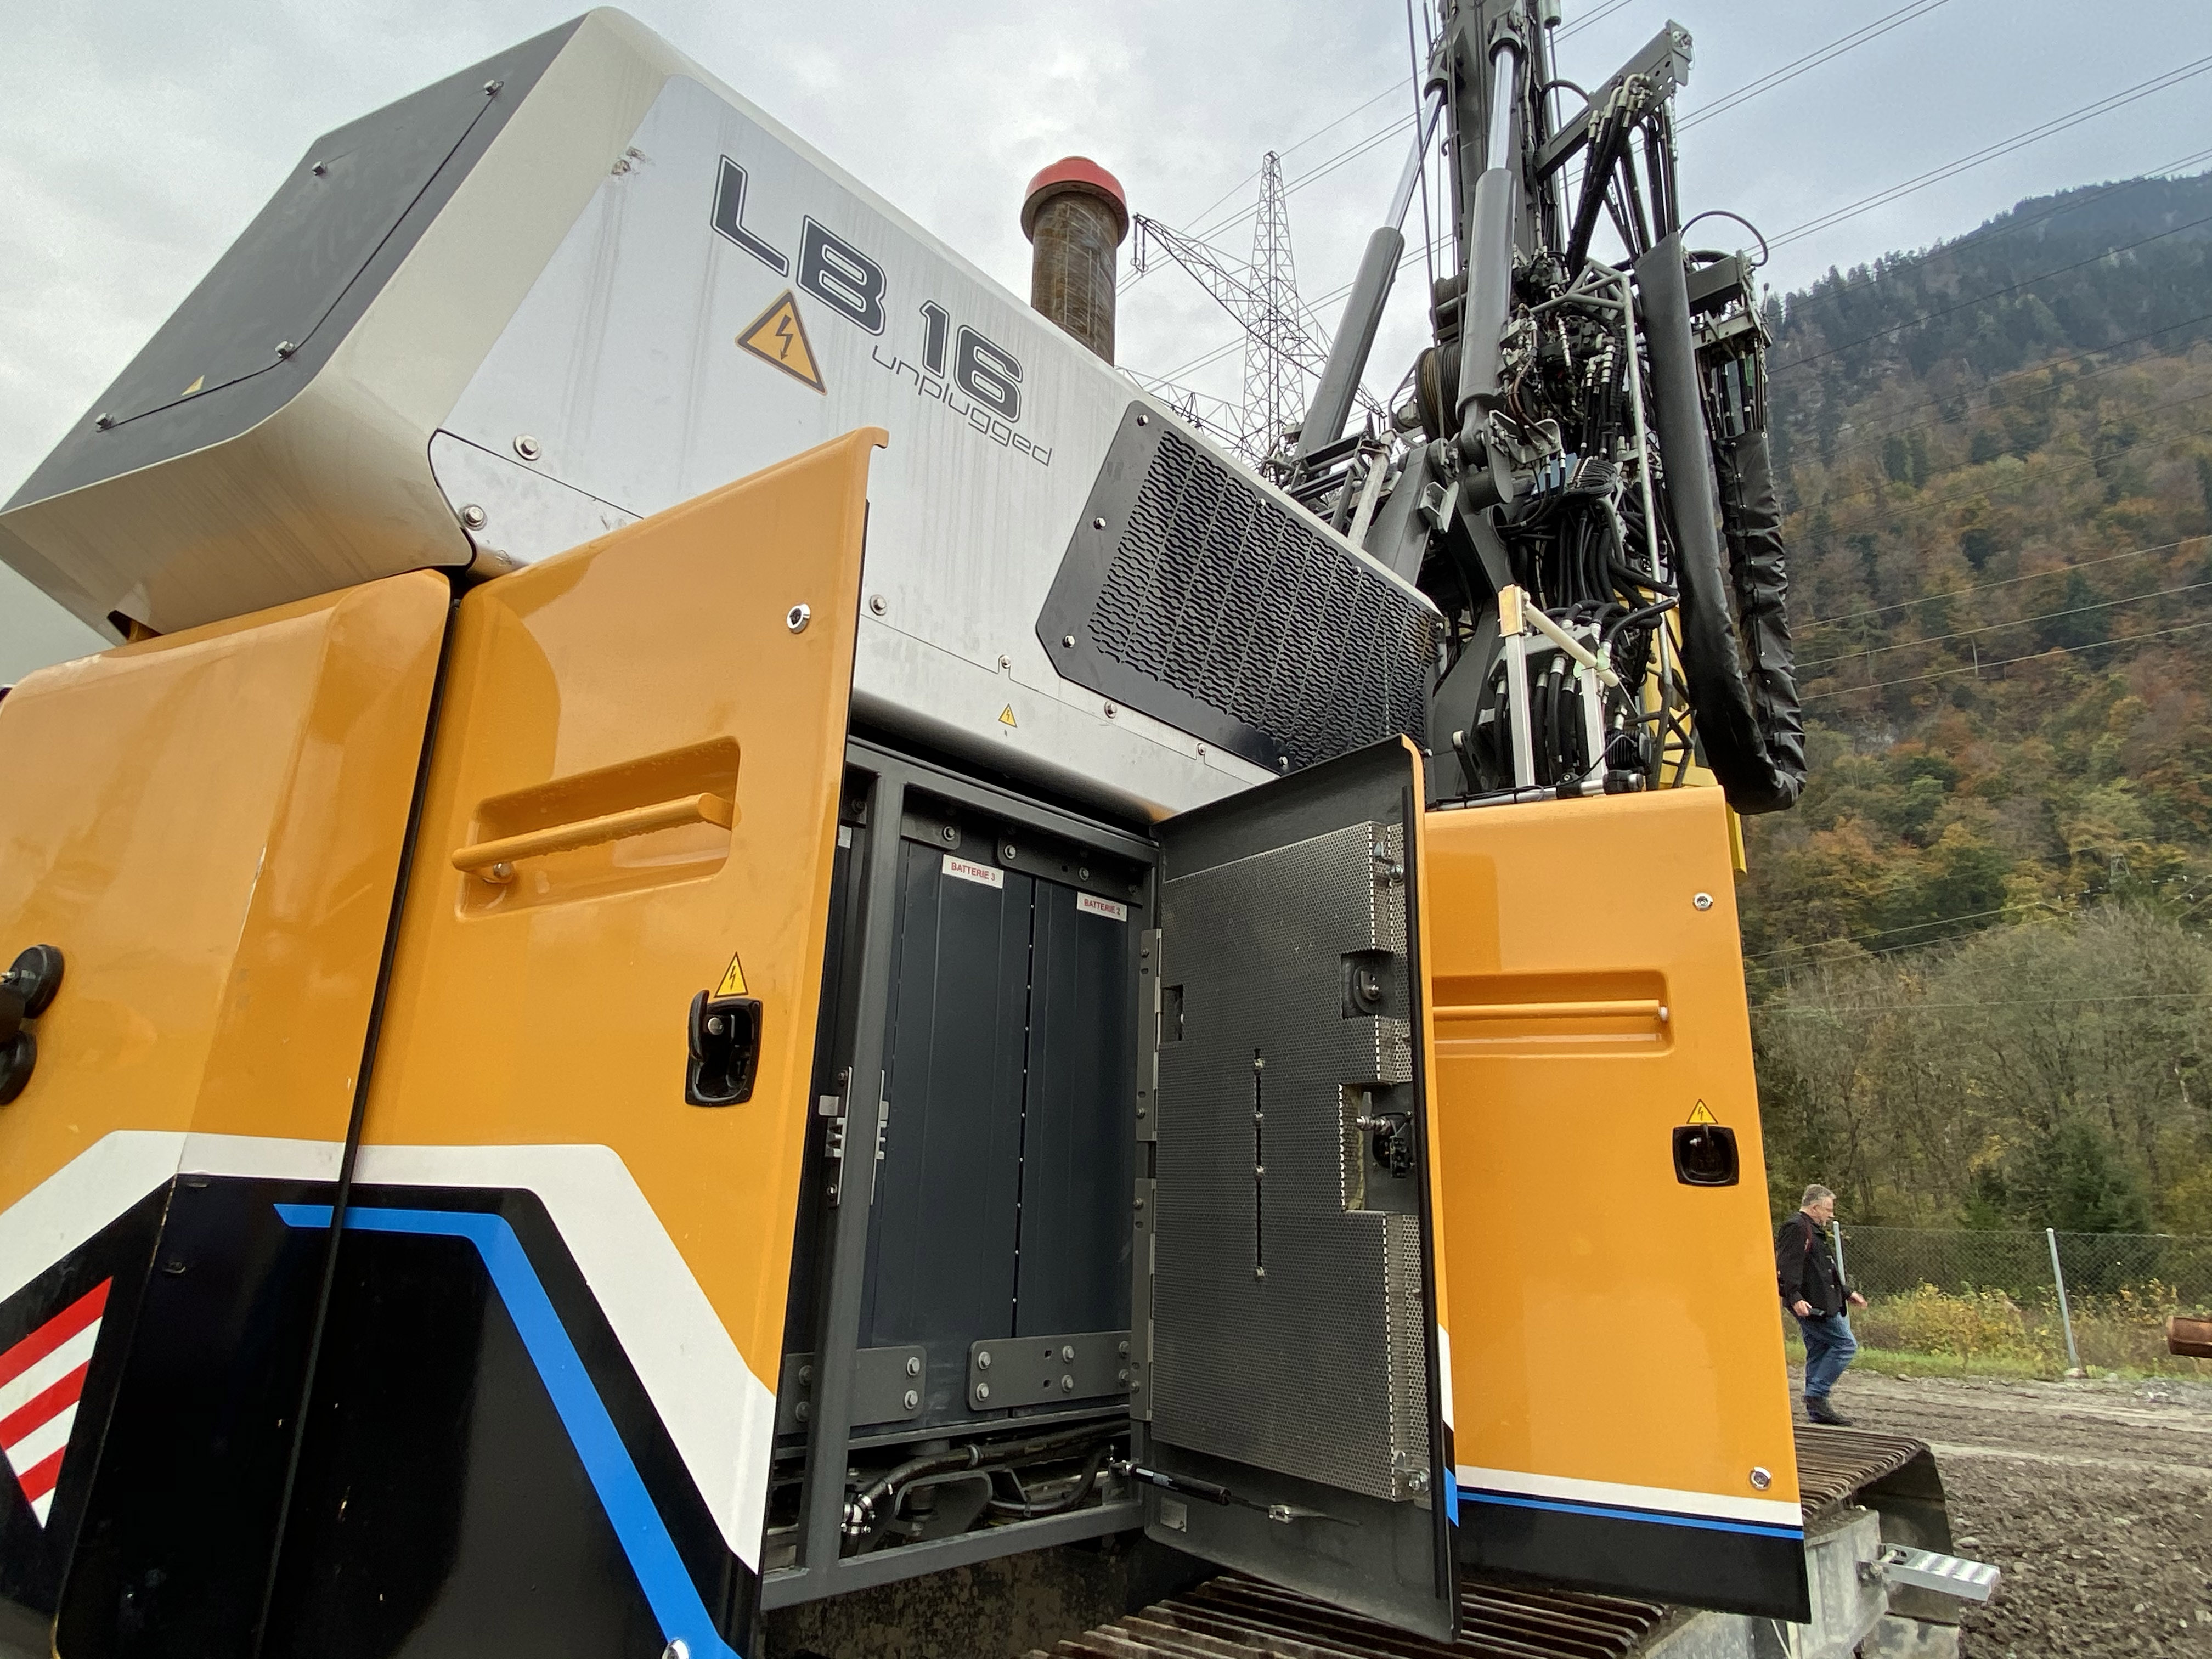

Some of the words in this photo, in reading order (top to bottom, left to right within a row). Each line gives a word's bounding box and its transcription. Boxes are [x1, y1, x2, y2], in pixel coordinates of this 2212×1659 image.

[710, 154, 887, 336] LB
[919, 300, 1023, 422] 16
[872, 345, 1052, 467] unplugged
[951, 862, 989, 879] BATTERIE
[991, 872, 995, 881] 3
[1084, 899, 1116, 913] BATTERIE
[1116, 906, 1120, 915] 2
